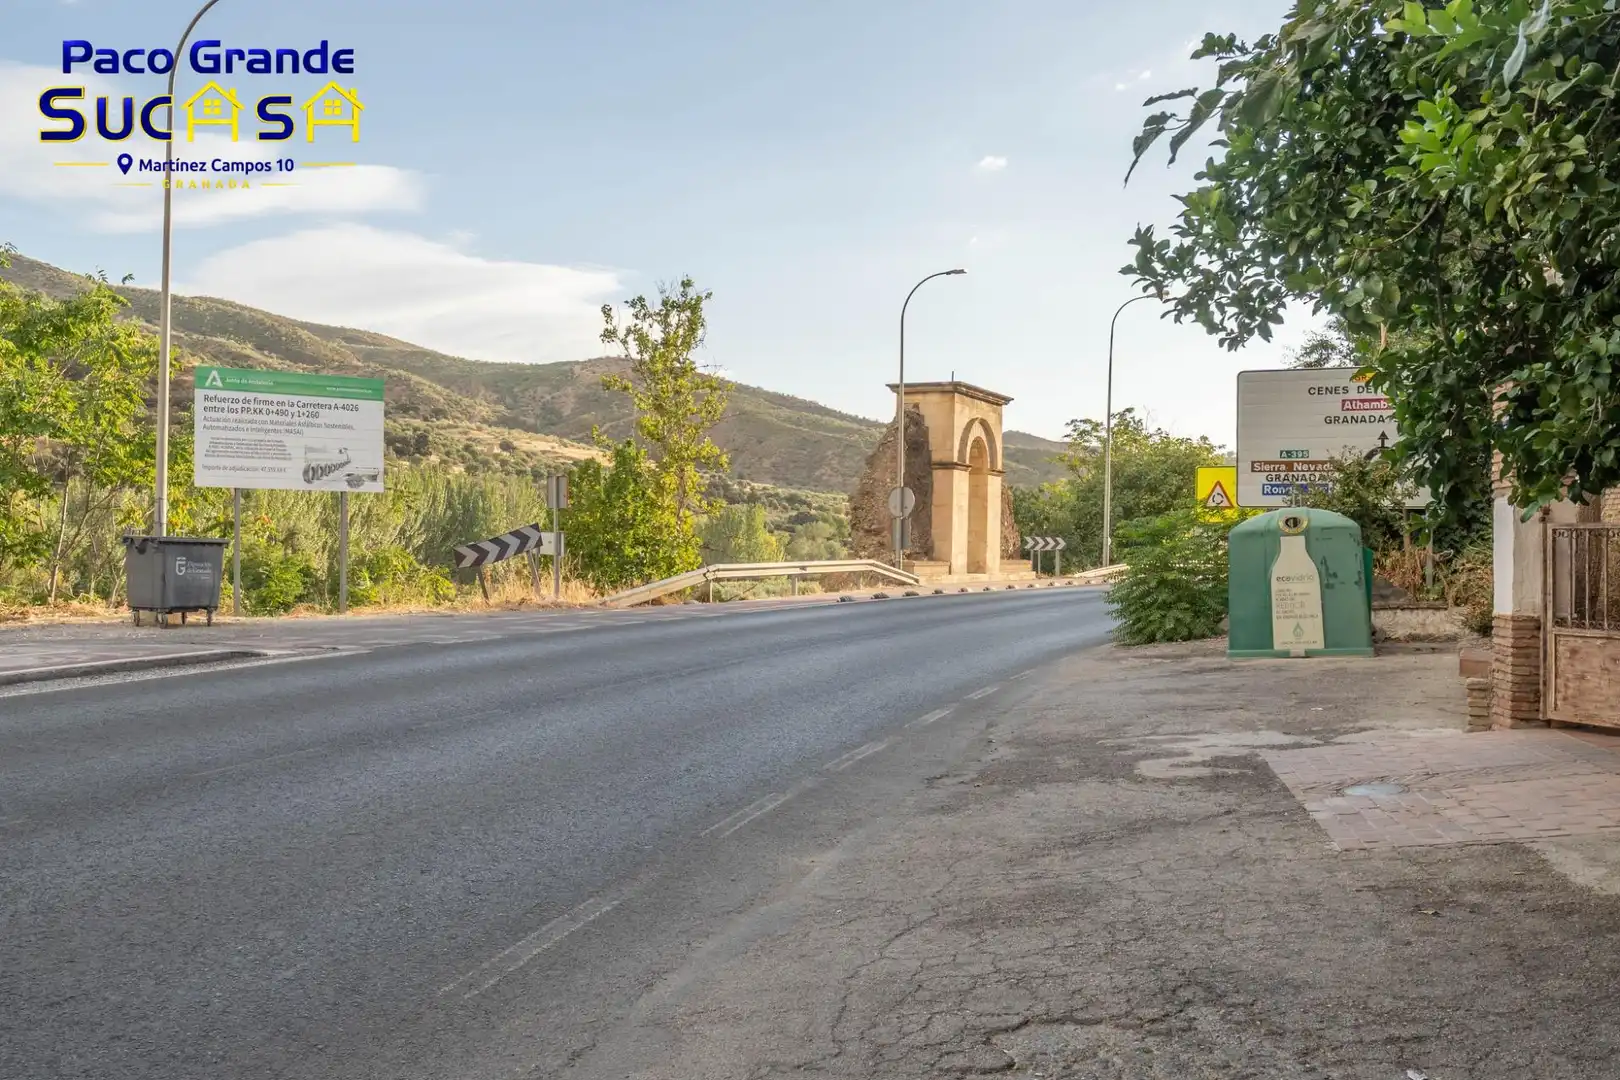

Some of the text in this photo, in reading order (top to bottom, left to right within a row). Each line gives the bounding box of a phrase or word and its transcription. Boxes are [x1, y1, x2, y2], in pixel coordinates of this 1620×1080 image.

[1308, 385, 1349, 396] CENES
[204, 394, 360, 412] Refuerzo de firme en la Carretera A-4026
[1343, 400, 1389, 410] Alhamb
[203, 405, 226, 414] entre
[227, 406, 239, 414] los
[265, 408, 289, 417] 0+490
[290, 411, 296, 419] y
[297, 410, 320, 419] 1+260
[1324, 414, 1386, 425] GRANADA
[1253, 462, 1286, 471] Sierra
